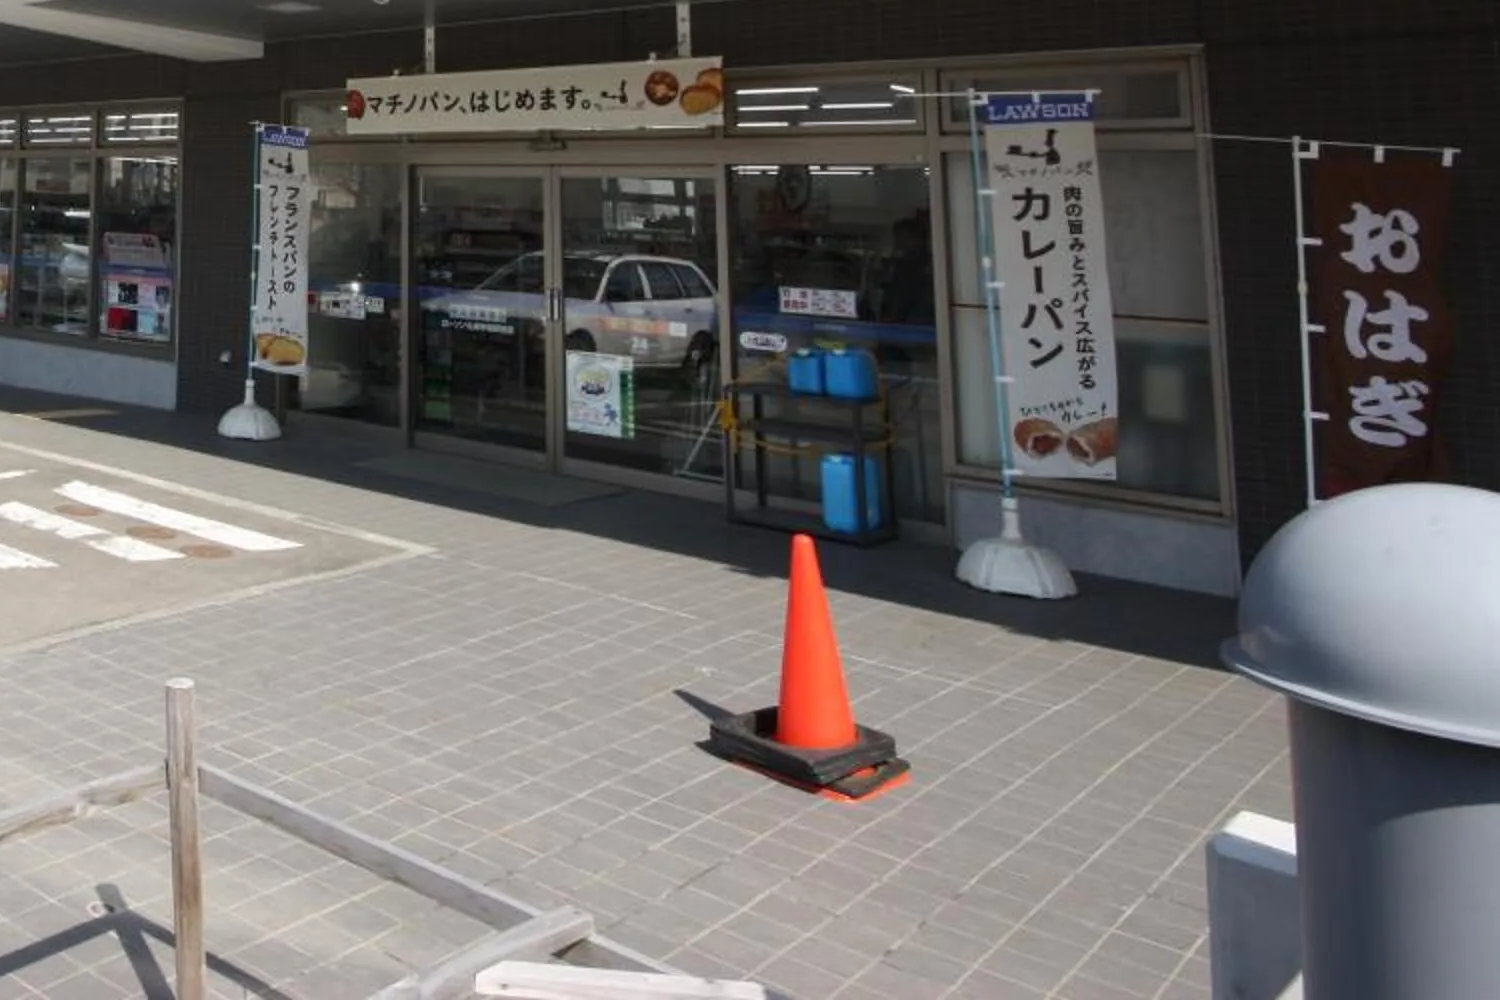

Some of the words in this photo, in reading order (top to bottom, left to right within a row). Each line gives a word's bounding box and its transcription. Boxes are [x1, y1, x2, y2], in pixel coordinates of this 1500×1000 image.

[366, 86, 592, 115] マチノパン、はじめます。
[988, 103, 1089, 120] LAWSON
[267, 185, 279, 310] フレンチトースト
[283, 186, 300, 293] フランスパンの
[1011, 186, 1065, 369] カレーパン
[1063, 185, 1097, 390] 肉の旨みとスパイス広がる
[1339, 202, 1430, 447] おはぎ
